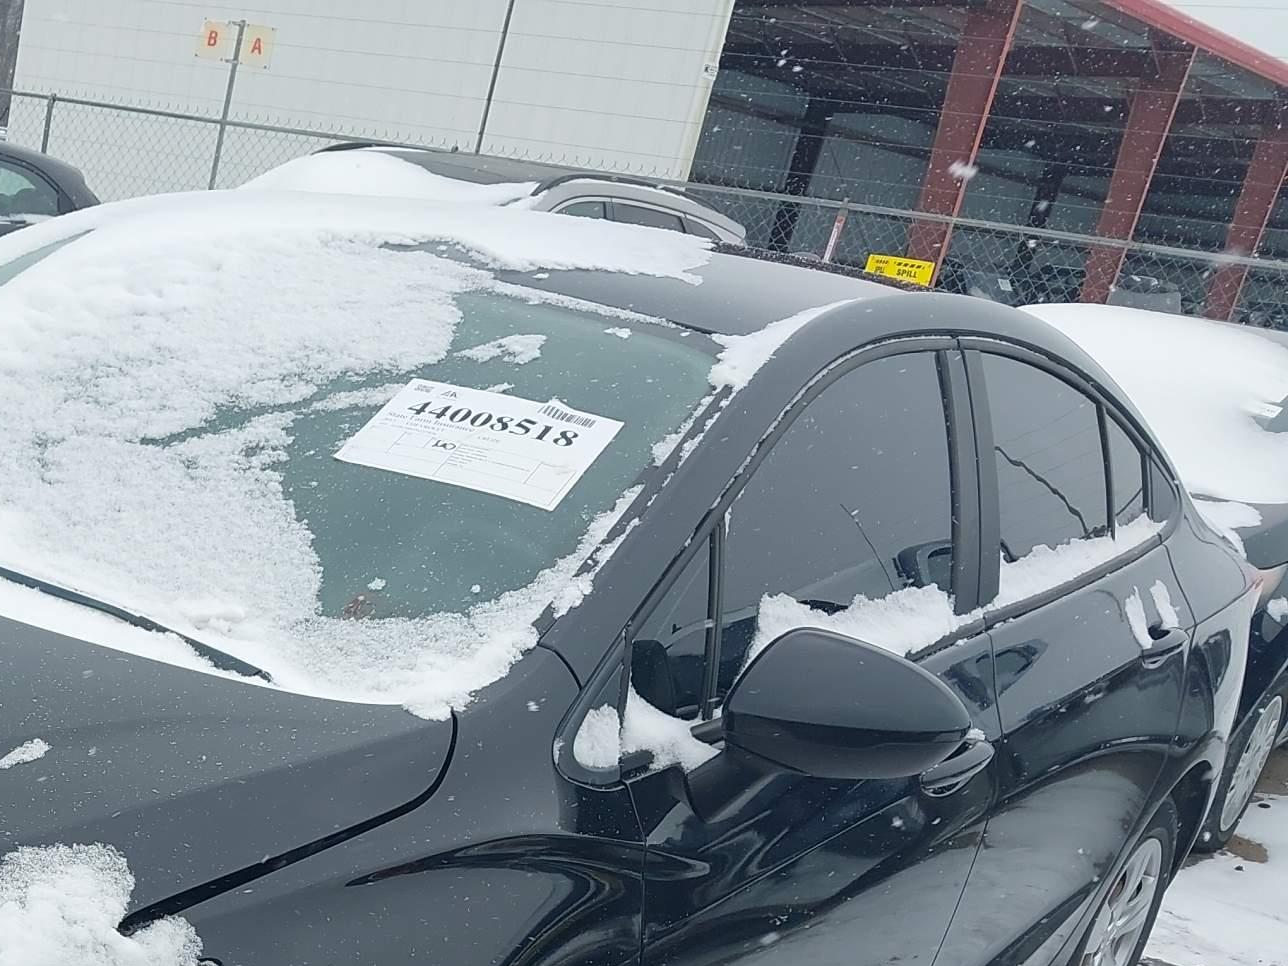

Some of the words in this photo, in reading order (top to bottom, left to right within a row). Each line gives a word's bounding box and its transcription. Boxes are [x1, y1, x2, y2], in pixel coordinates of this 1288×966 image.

[207, 30, 218, 47] B
[250, 37, 262, 55] A
[896, 268, 918, 279] SPILL
[407, 400, 579, 448] 44008518
